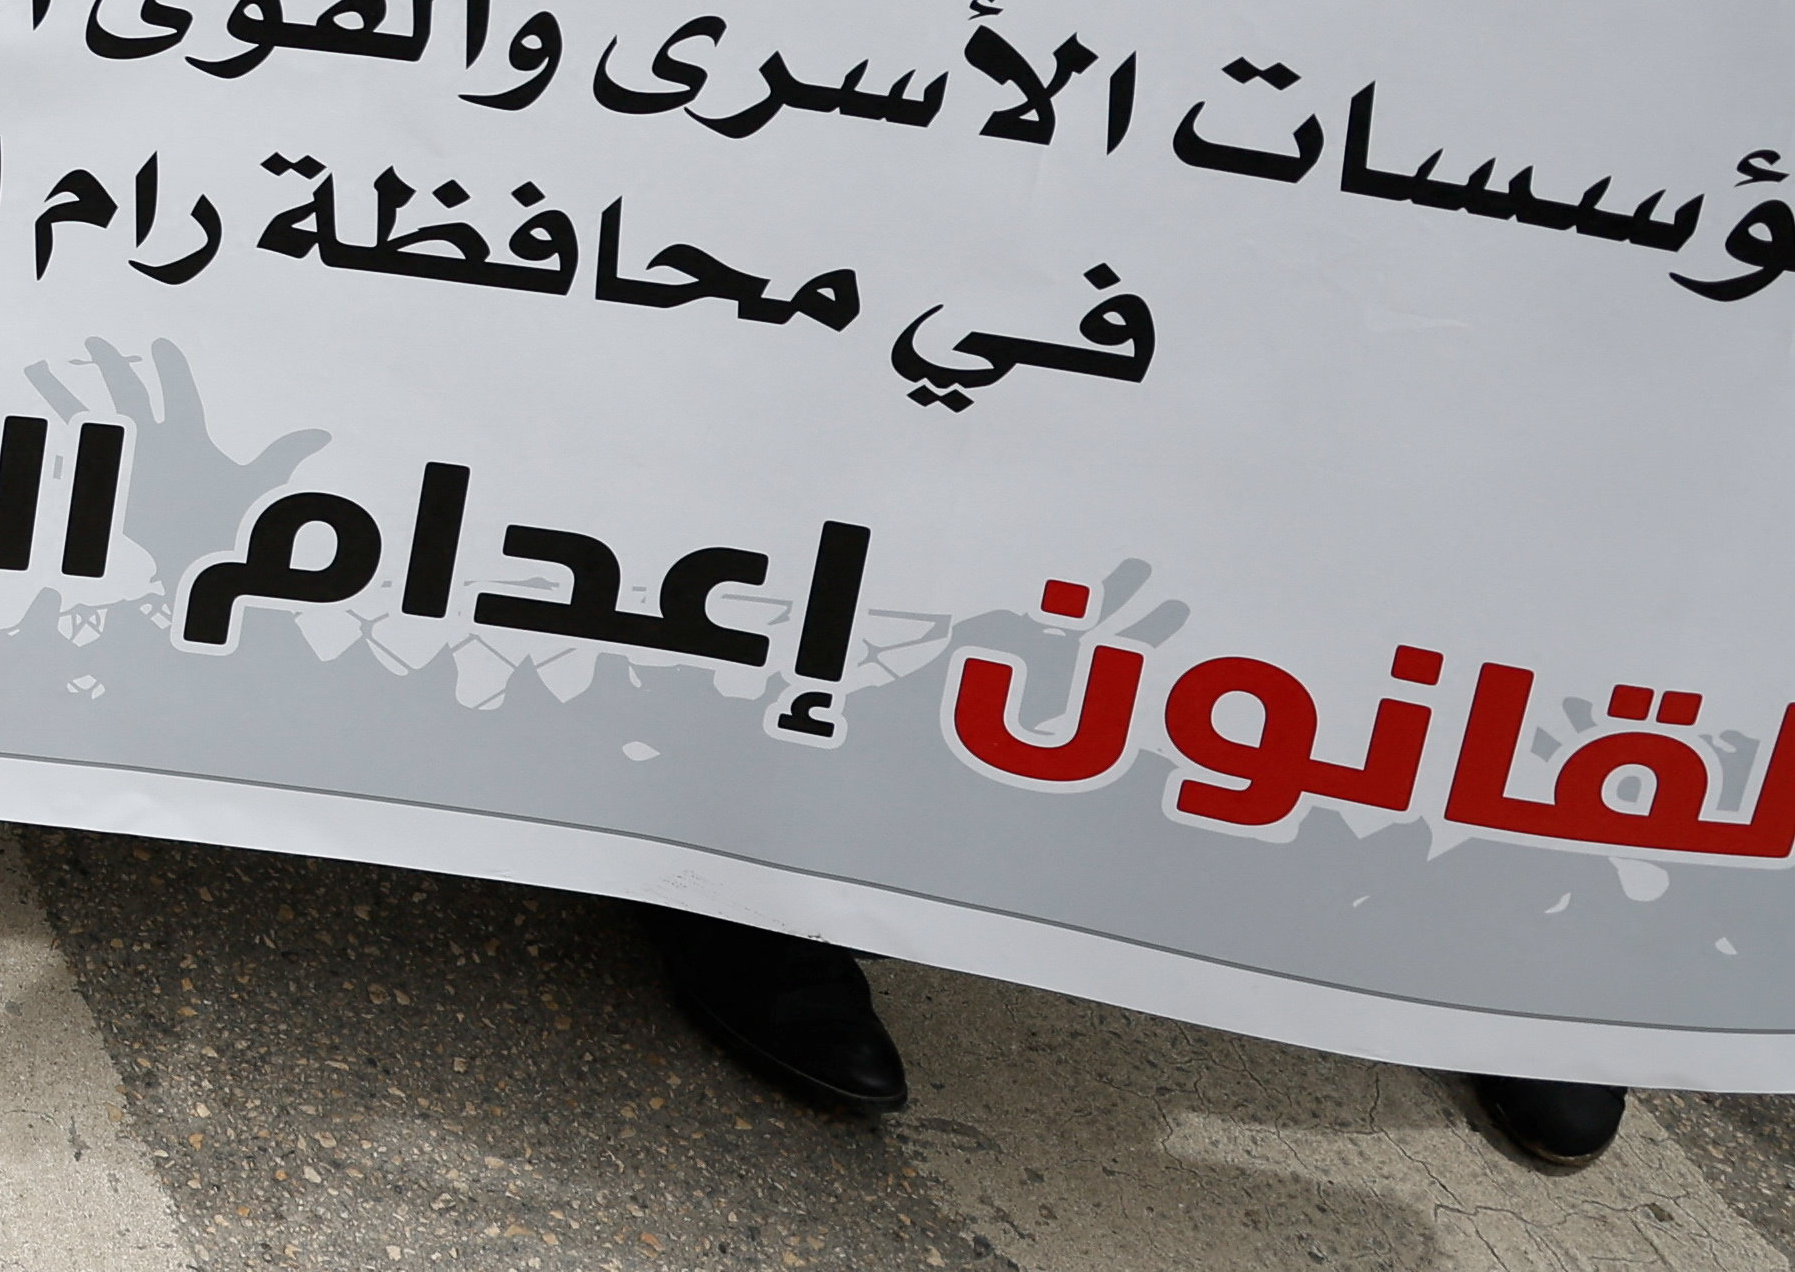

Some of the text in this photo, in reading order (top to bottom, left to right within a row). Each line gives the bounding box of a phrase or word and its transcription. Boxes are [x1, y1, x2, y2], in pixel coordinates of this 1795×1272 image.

[35, 152, 221, 284] رام
[257, 152, 860, 331] محافظة
[1173, 57, 1795, 302] ؤسسات
[891, 263, 1155, 412] في
[184, 462, 870, 737] إعدام
